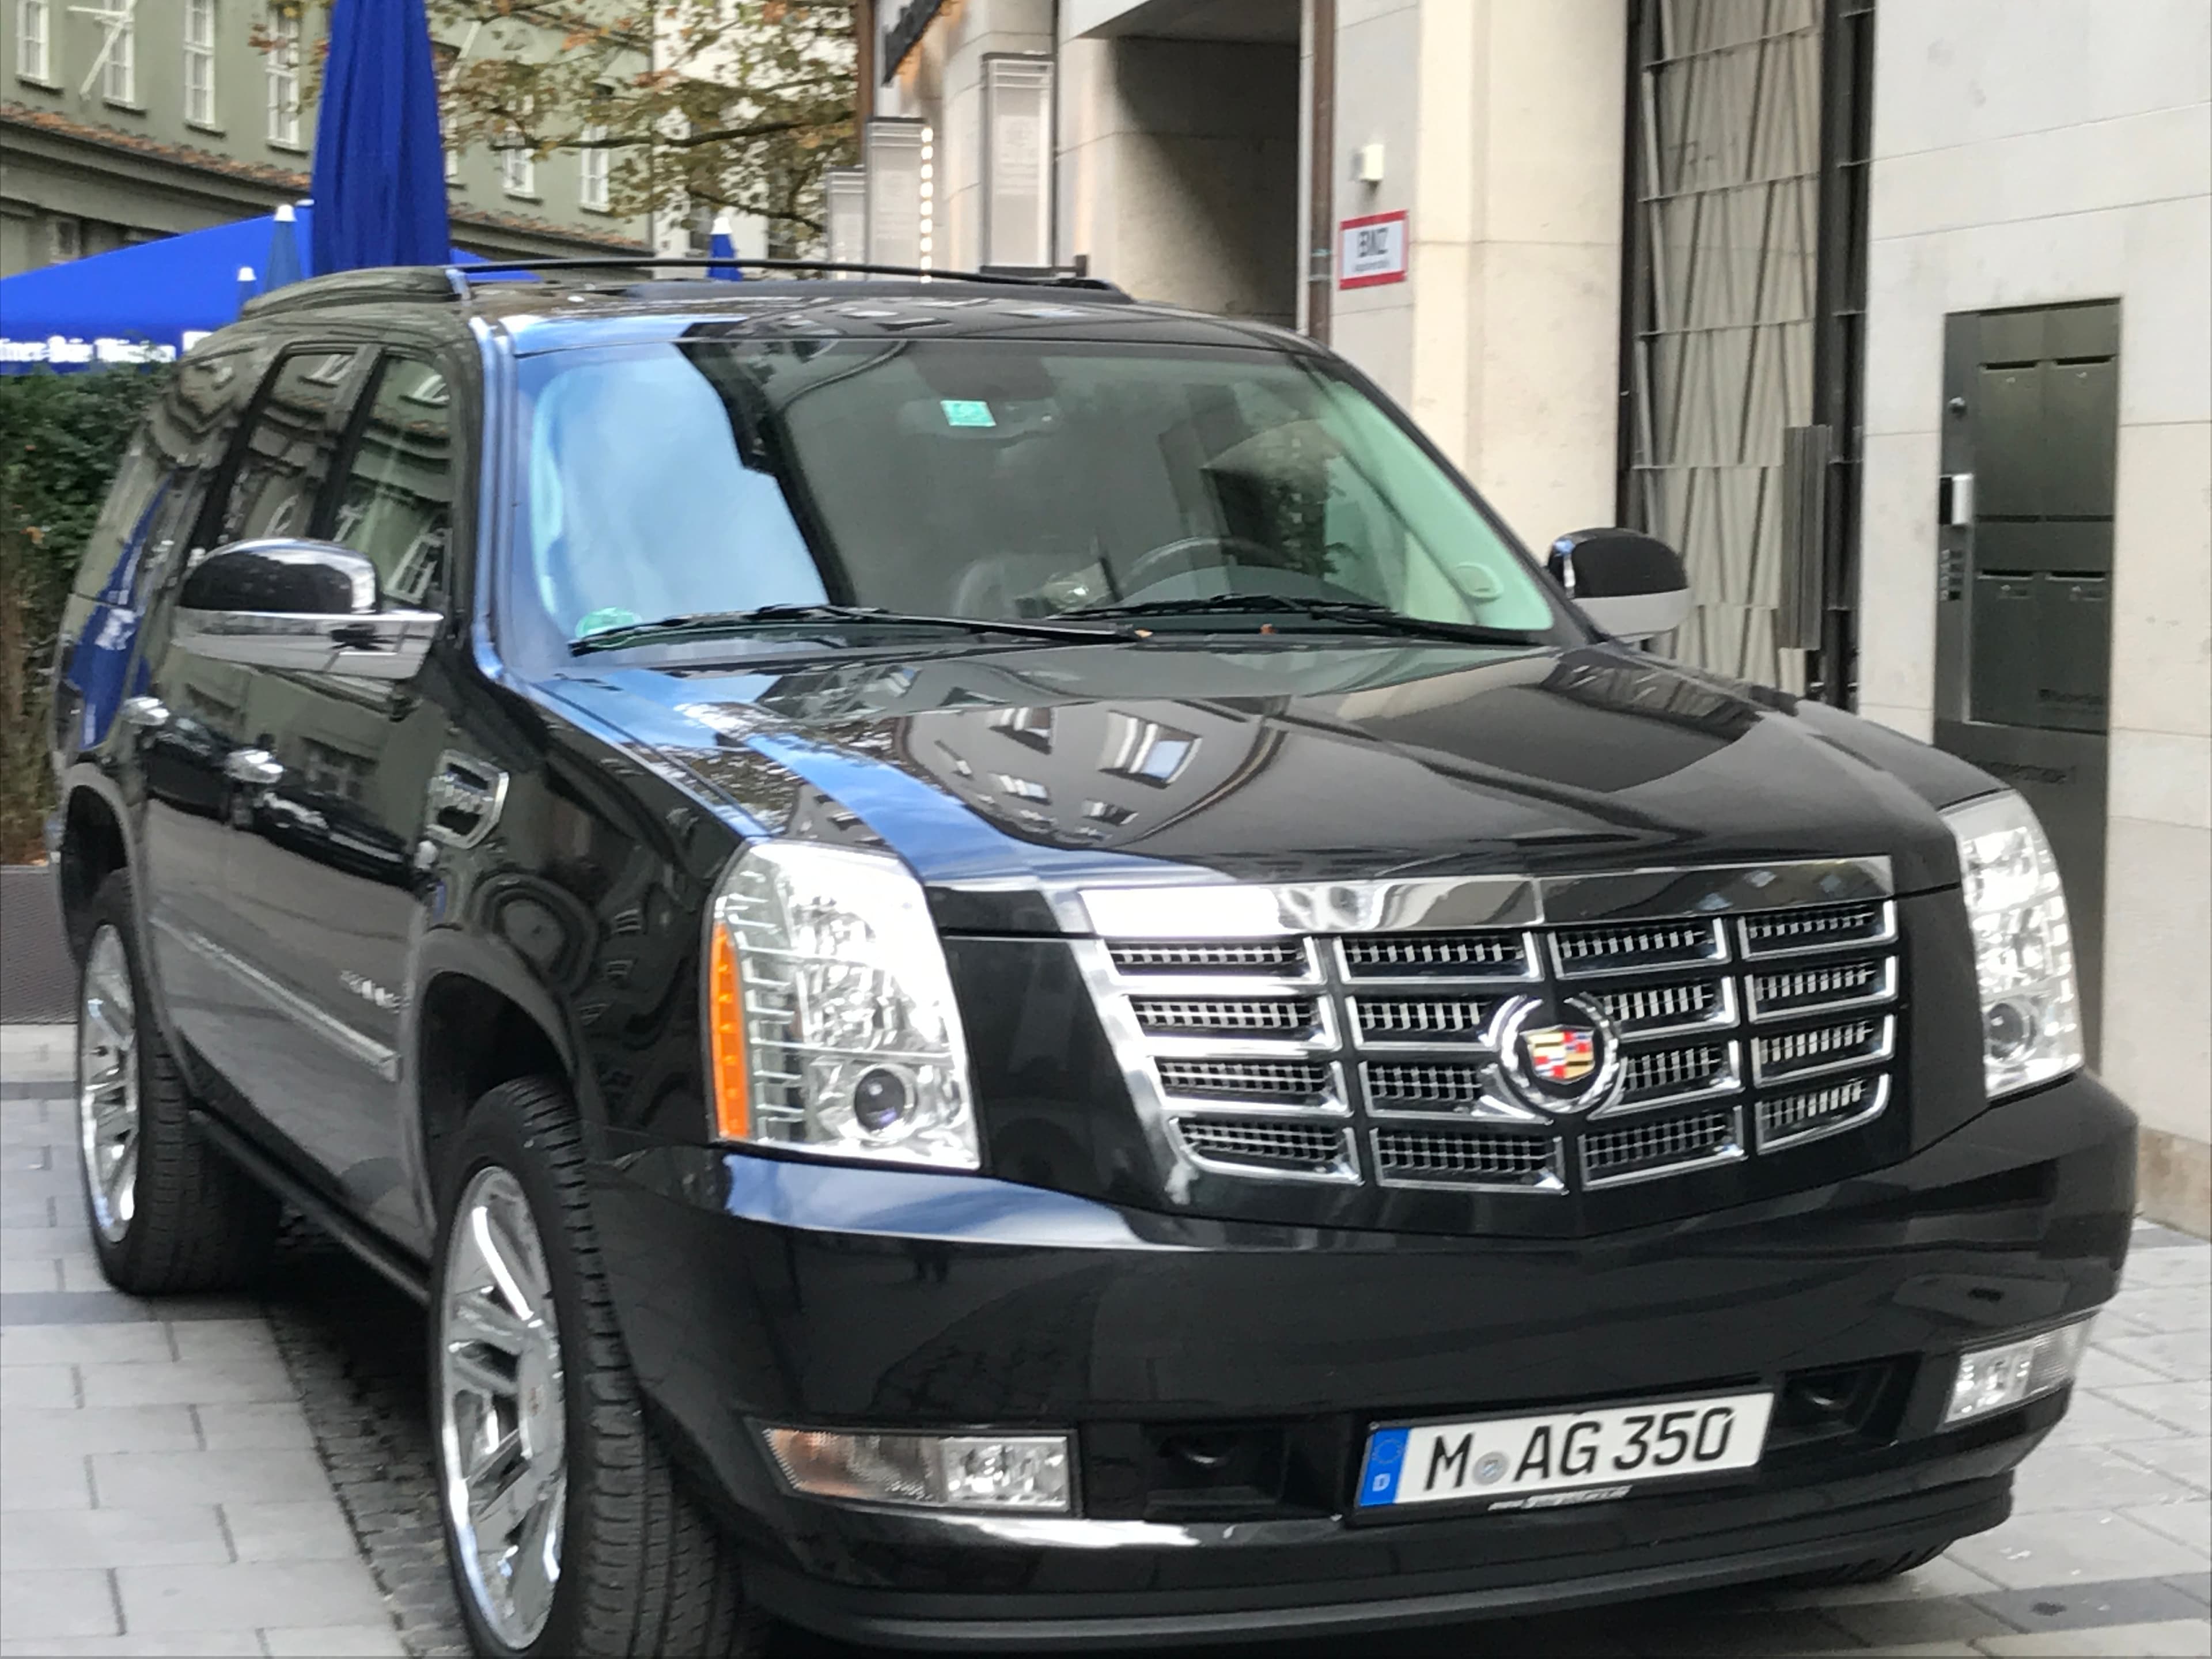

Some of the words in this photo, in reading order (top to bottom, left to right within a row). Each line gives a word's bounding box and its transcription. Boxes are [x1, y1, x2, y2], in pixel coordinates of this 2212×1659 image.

[1425, 1432, 1473, 1491] M
[1513, 1421, 1601, 1482] AG
[1613, 1406, 1734, 1471] 350
[1373, 1474, 1391, 1491] D
